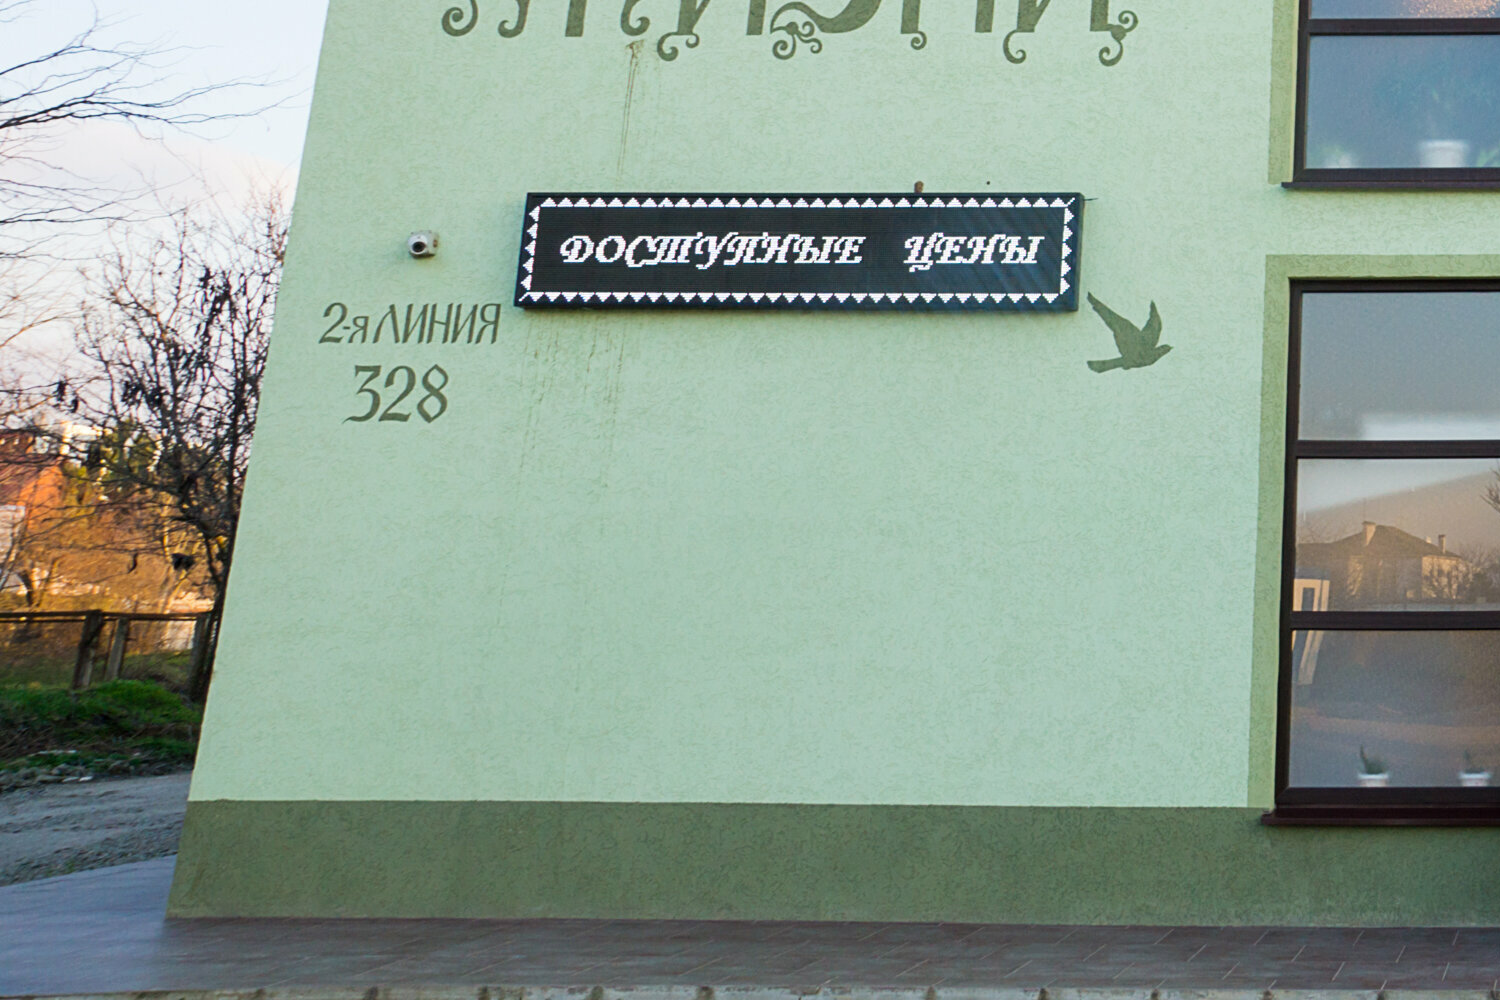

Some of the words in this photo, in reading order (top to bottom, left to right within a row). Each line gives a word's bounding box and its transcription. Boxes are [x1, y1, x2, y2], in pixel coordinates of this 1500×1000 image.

[560, 231, 867, 270] ДОСТУПНЫЕ
[903, 231, 1046, 273] ЦЕНЫ
[372, 303, 502, 344] ЛИНИЯ
[342, 364, 449, 424] 328
